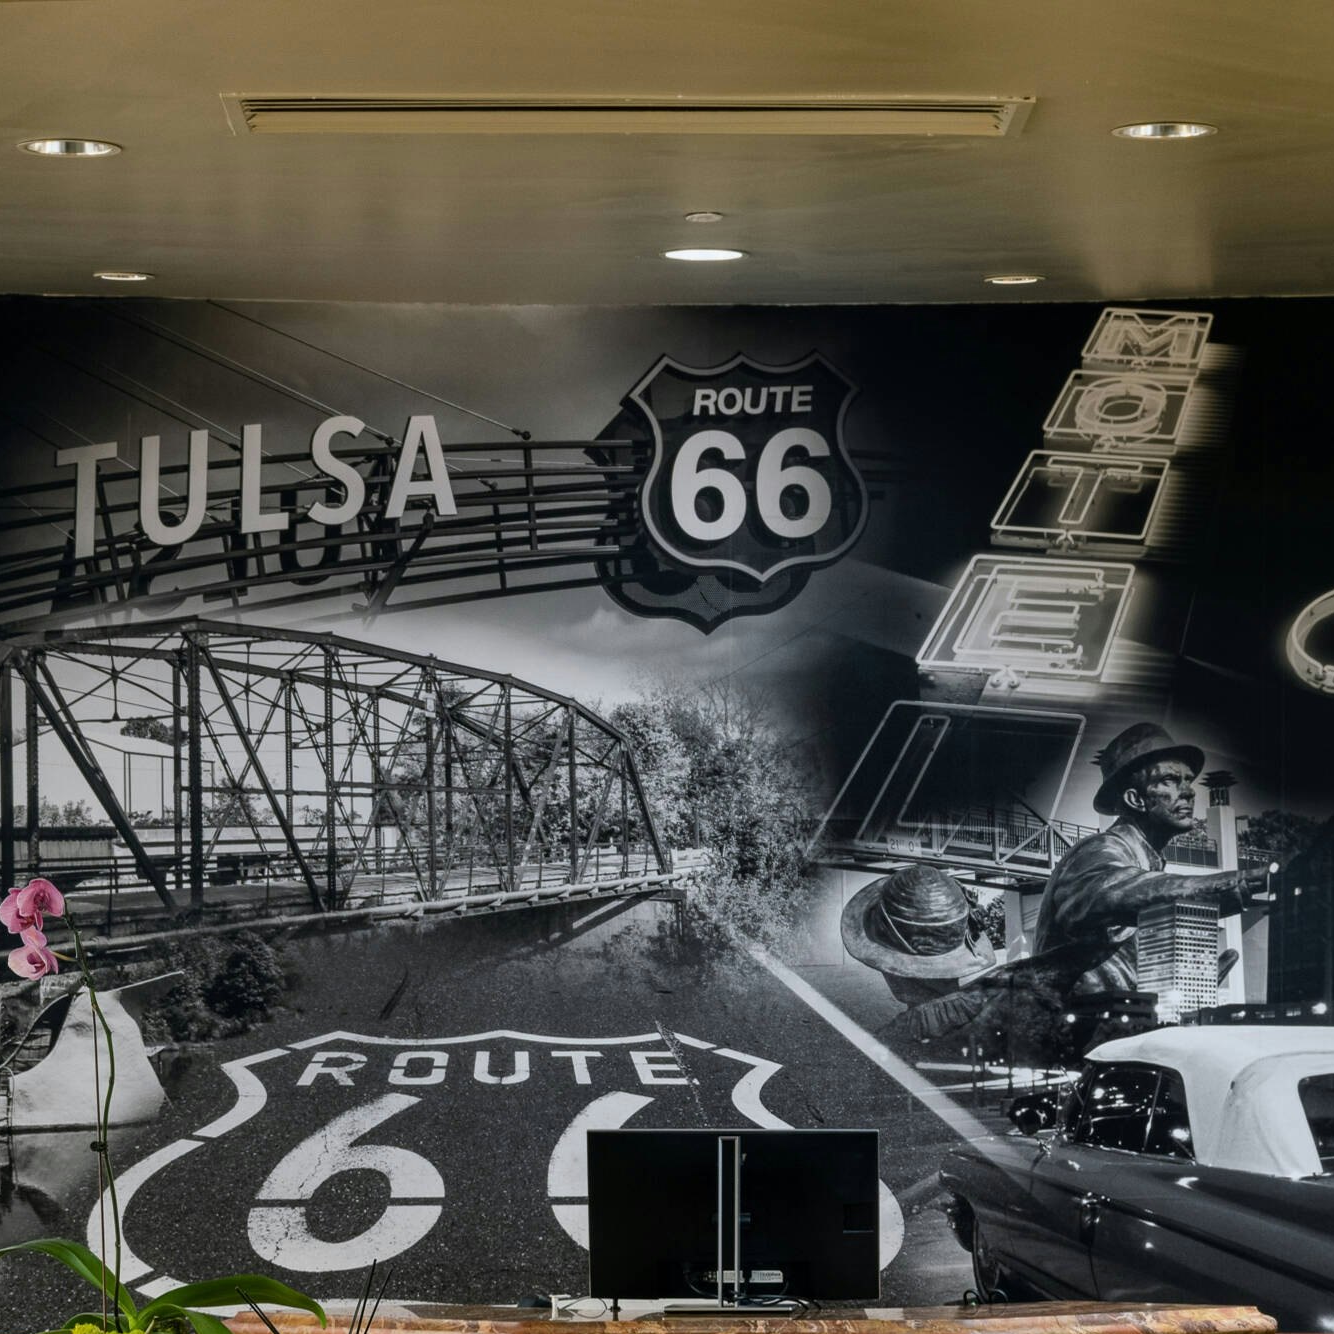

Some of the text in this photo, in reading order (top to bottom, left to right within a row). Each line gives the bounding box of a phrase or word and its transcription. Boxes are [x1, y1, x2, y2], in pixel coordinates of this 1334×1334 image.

[693, 384, 813, 416] ROUTE
[55, 416, 458, 558] TULSA
[670, 428, 832, 541] 66
[296, 1051, 700, 1087] ROUTE
